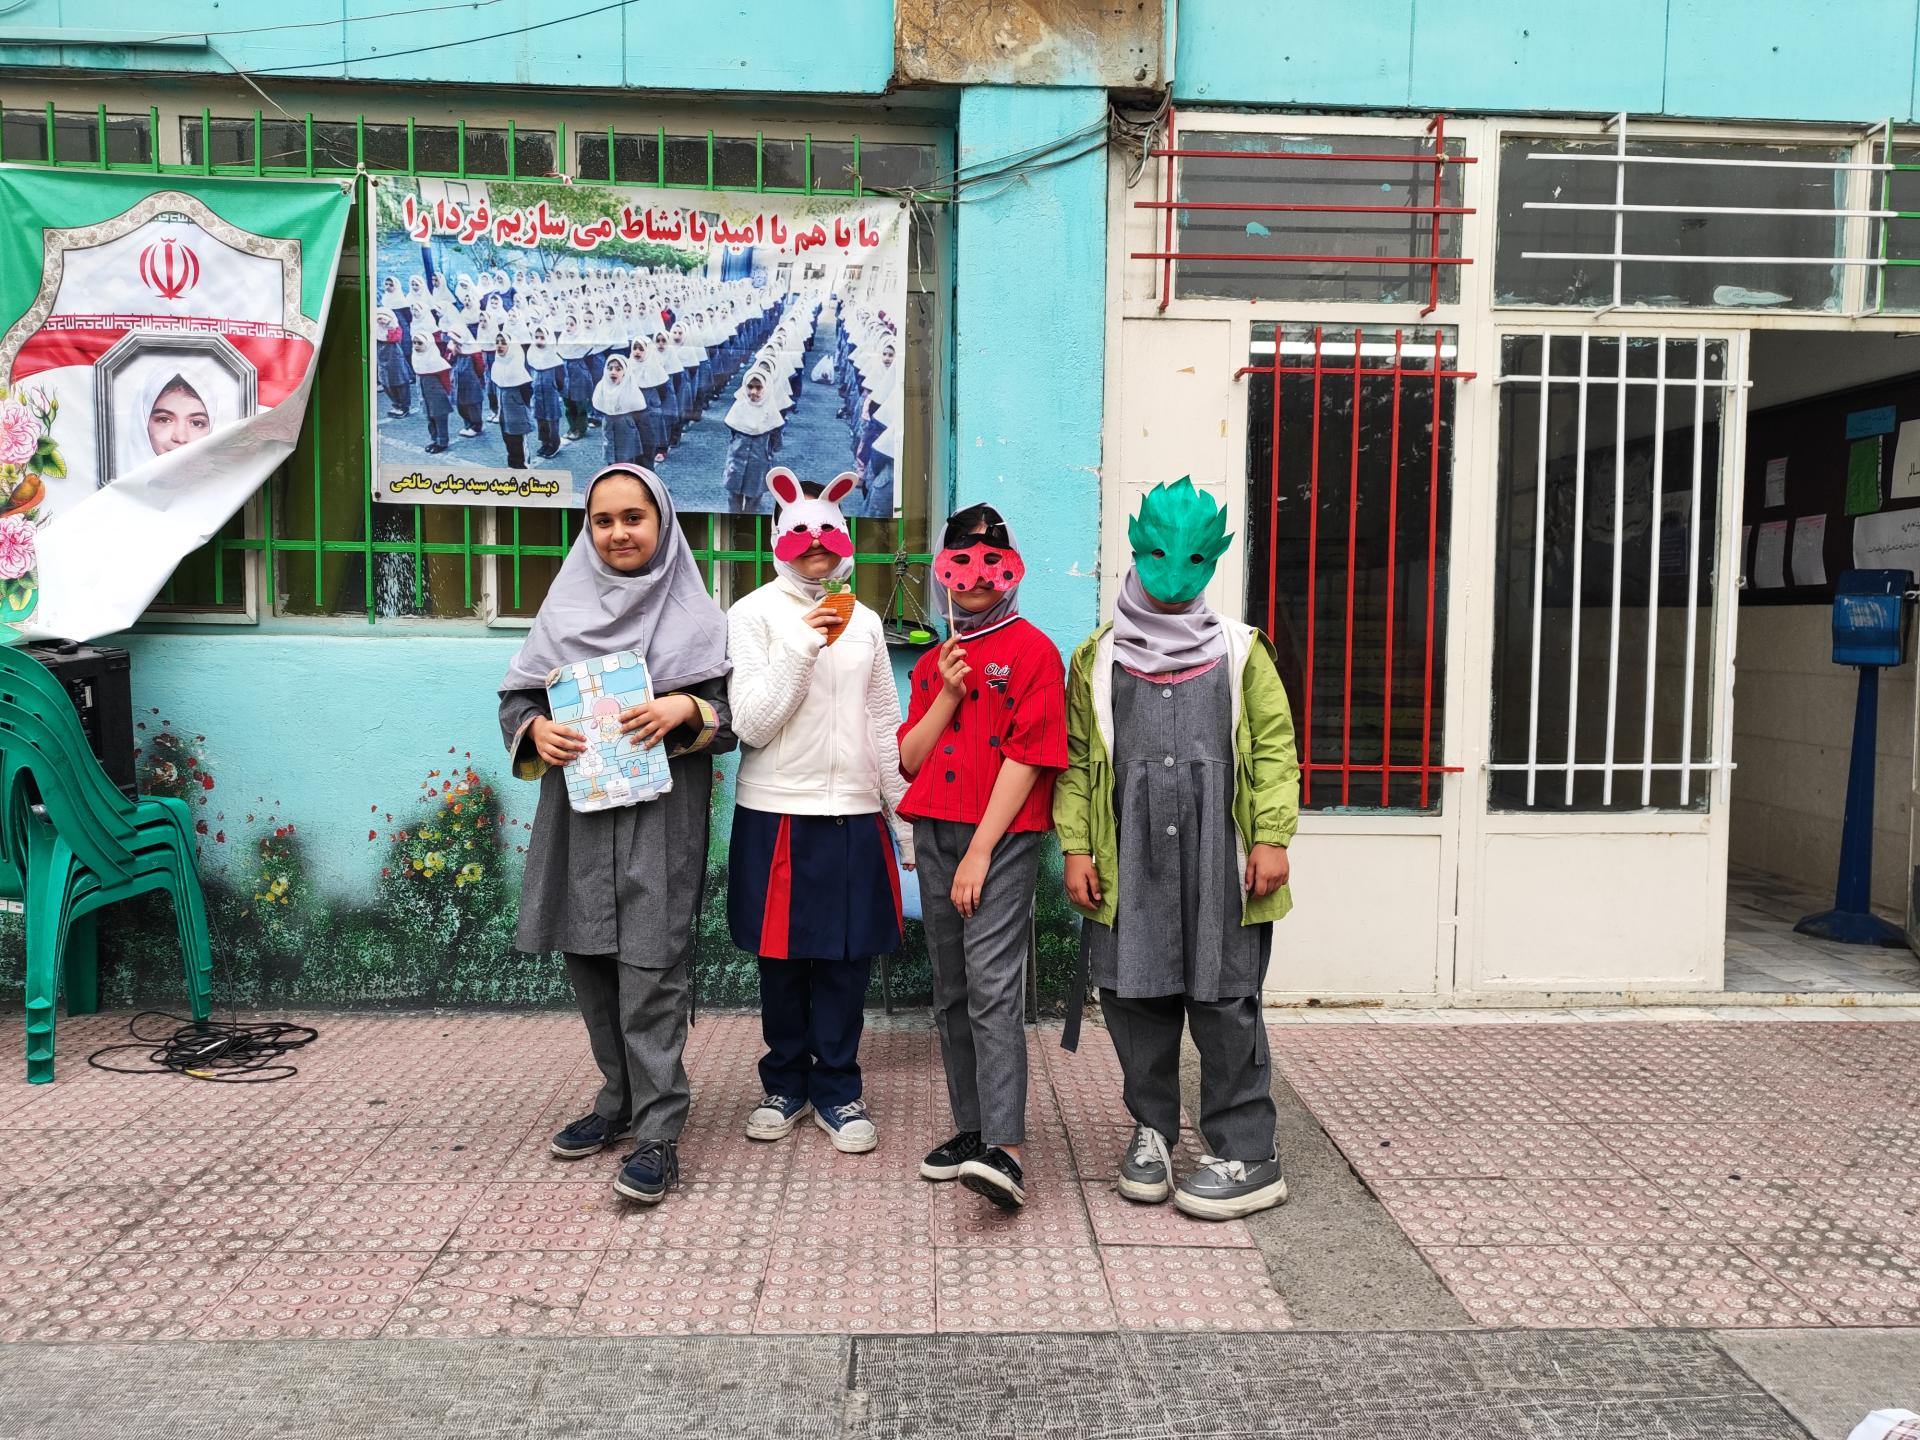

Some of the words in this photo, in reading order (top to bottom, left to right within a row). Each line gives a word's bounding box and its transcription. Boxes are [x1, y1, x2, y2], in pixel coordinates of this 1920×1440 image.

[404, 196, 430, 239] را
[436, 197, 490, 241] فردا
[496, 203, 566, 245] سازیم
[573, 219, 612, 247] می
[620, 207, 682, 241] نشاط
[688, 210, 707, 250] با
[714, 213, 763, 251] امید
[770, 213, 788, 254] با
[859, 217, 880, 248] ما
[794, 223, 827, 256] هم
[834, 216, 851, 256] با
[390, 472, 432, 492] صالحی
[432, 474, 465, 495] عباس
[465, 478, 489, 494] سید
[489, 476, 518, 495] شهید
[518, 476, 559, 497] دبستان
